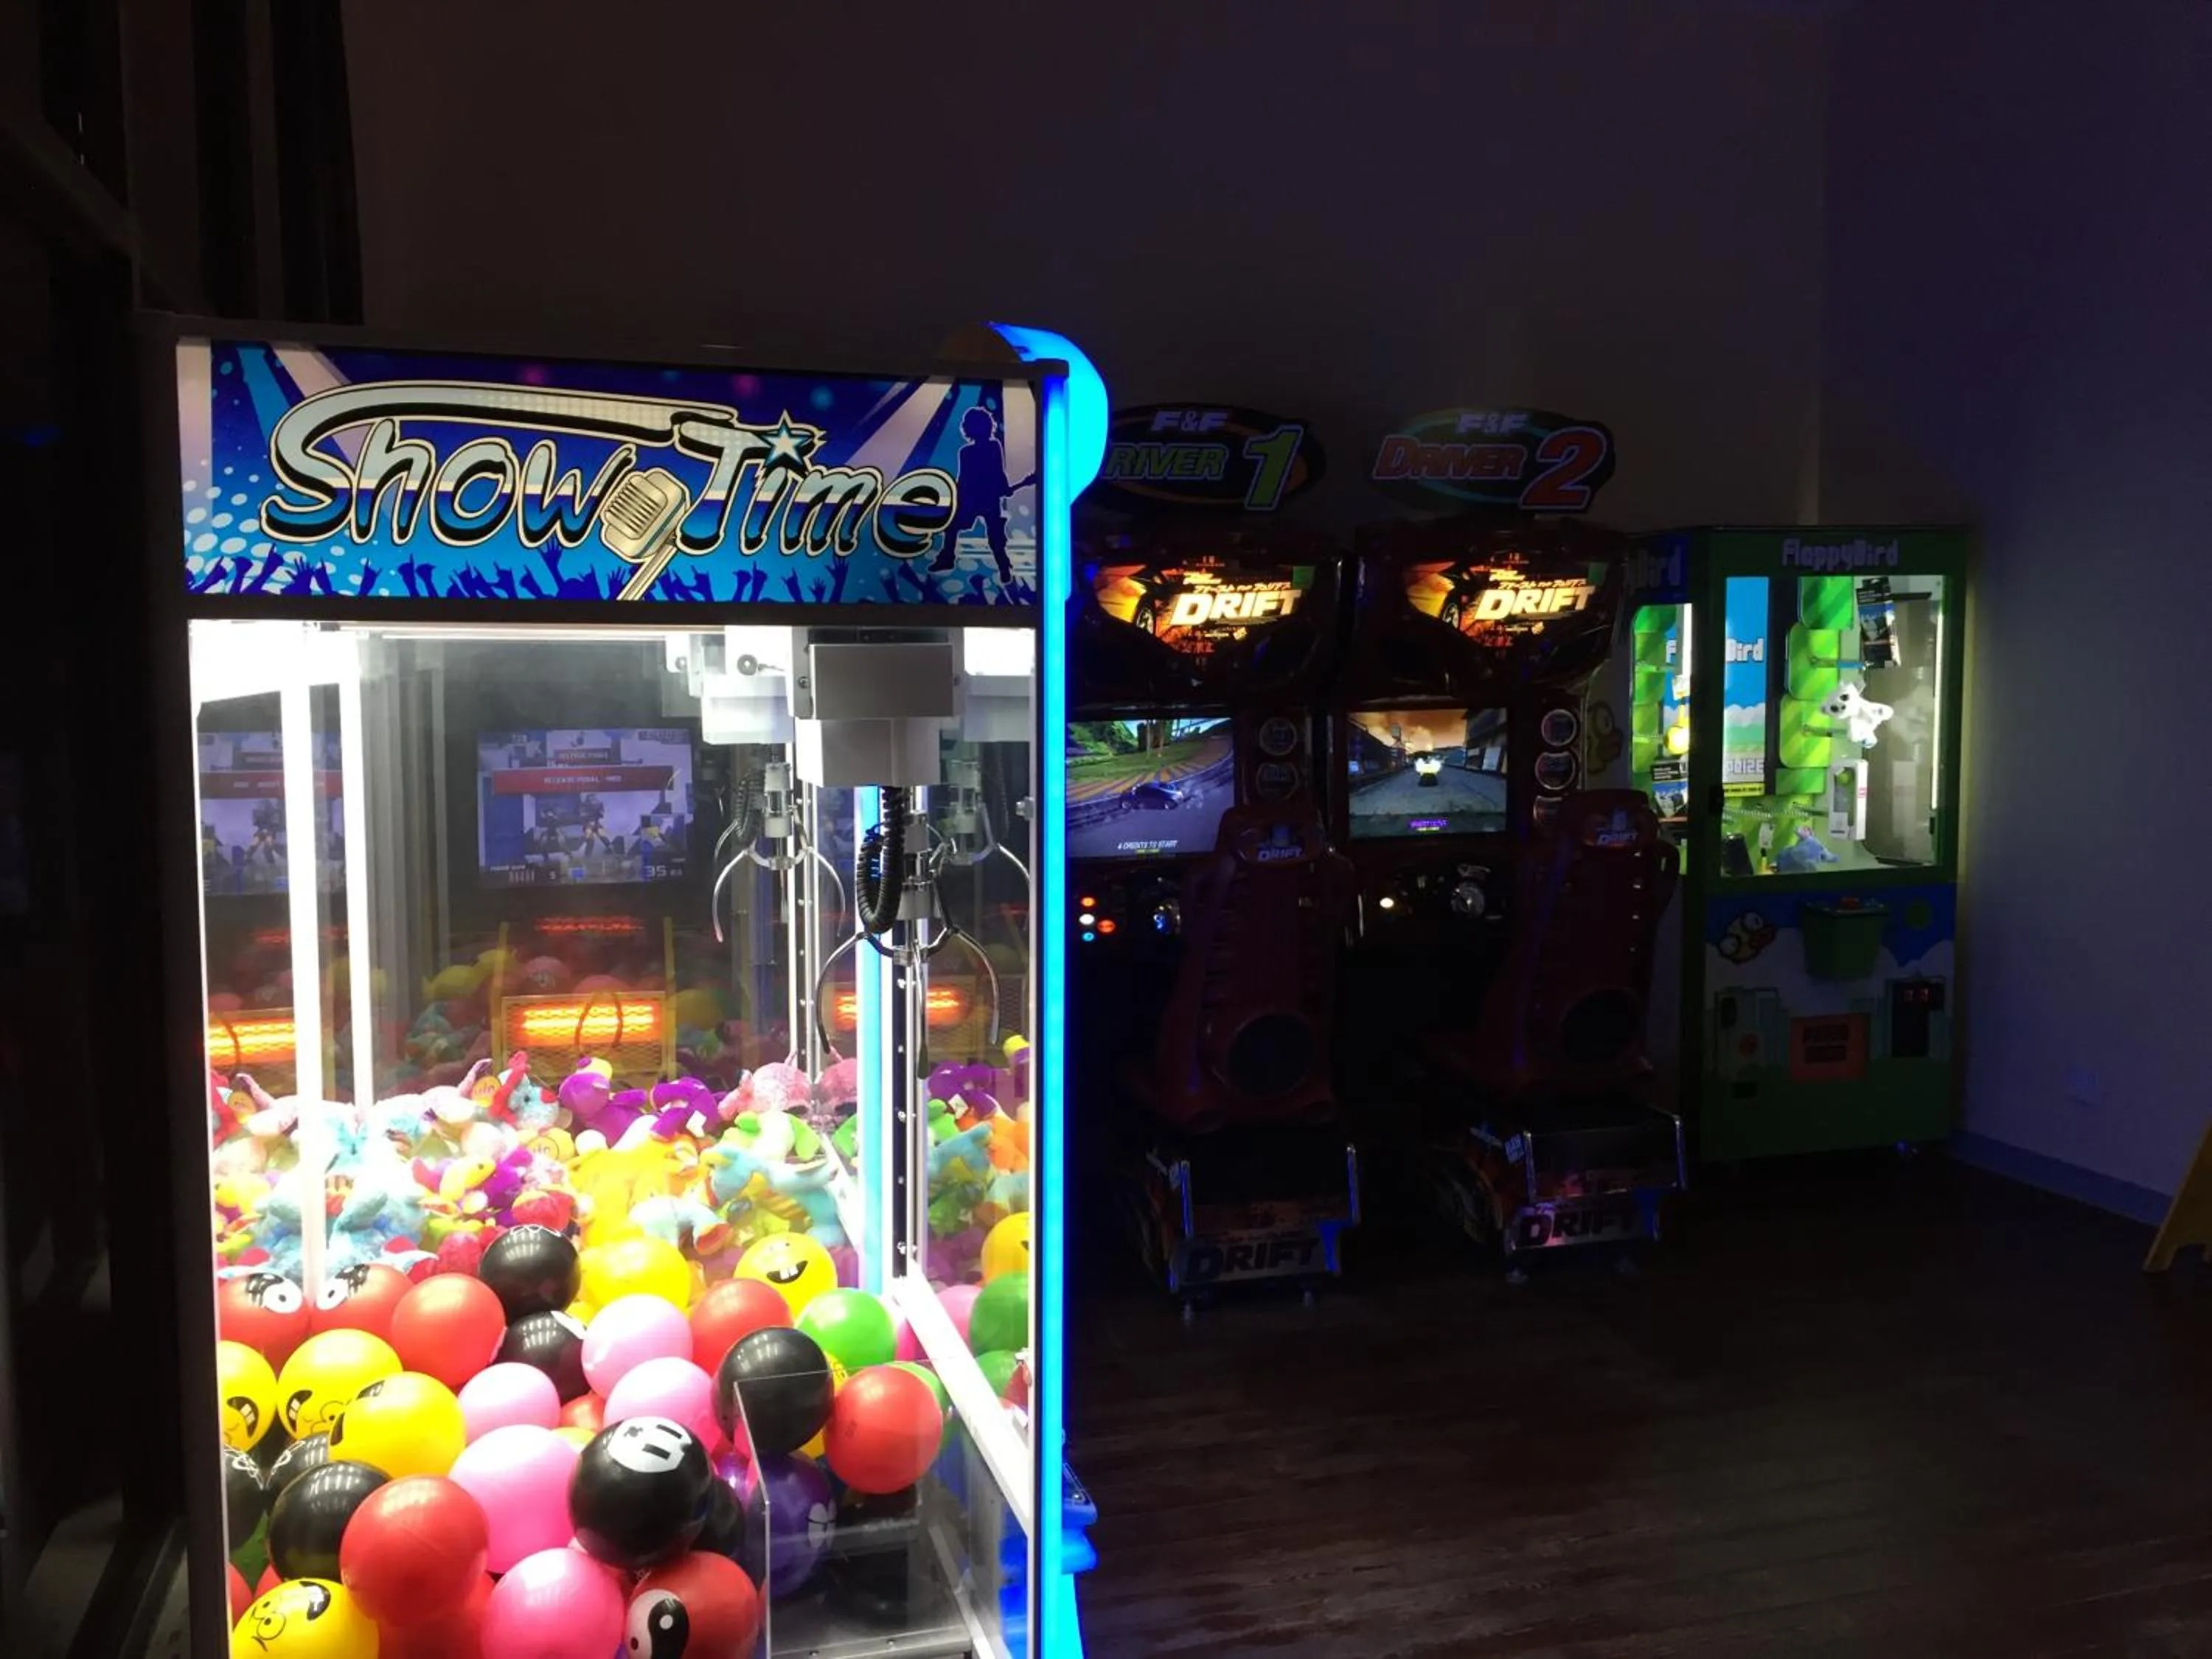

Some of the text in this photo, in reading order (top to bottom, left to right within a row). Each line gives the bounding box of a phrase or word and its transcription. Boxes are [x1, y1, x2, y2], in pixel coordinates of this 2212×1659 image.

[1150, 411, 1228, 432] F&F
[1455, 411, 1531, 434] F&F
[670, 411, 957, 558] Time
[1101, 424, 1304, 512] RIVER 1
[1372, 425, 1607, 510] DRIVER 2
[1169, 589, 1303, 626] DRIFT
[1474, 585, 1596, 620] DRIFT
[1258, 846, 1302, 862] DRIFT
[1520, 1211, 1641, 1245] DRIFT
[1183, 1238, 1321, 1282] DRIFT
